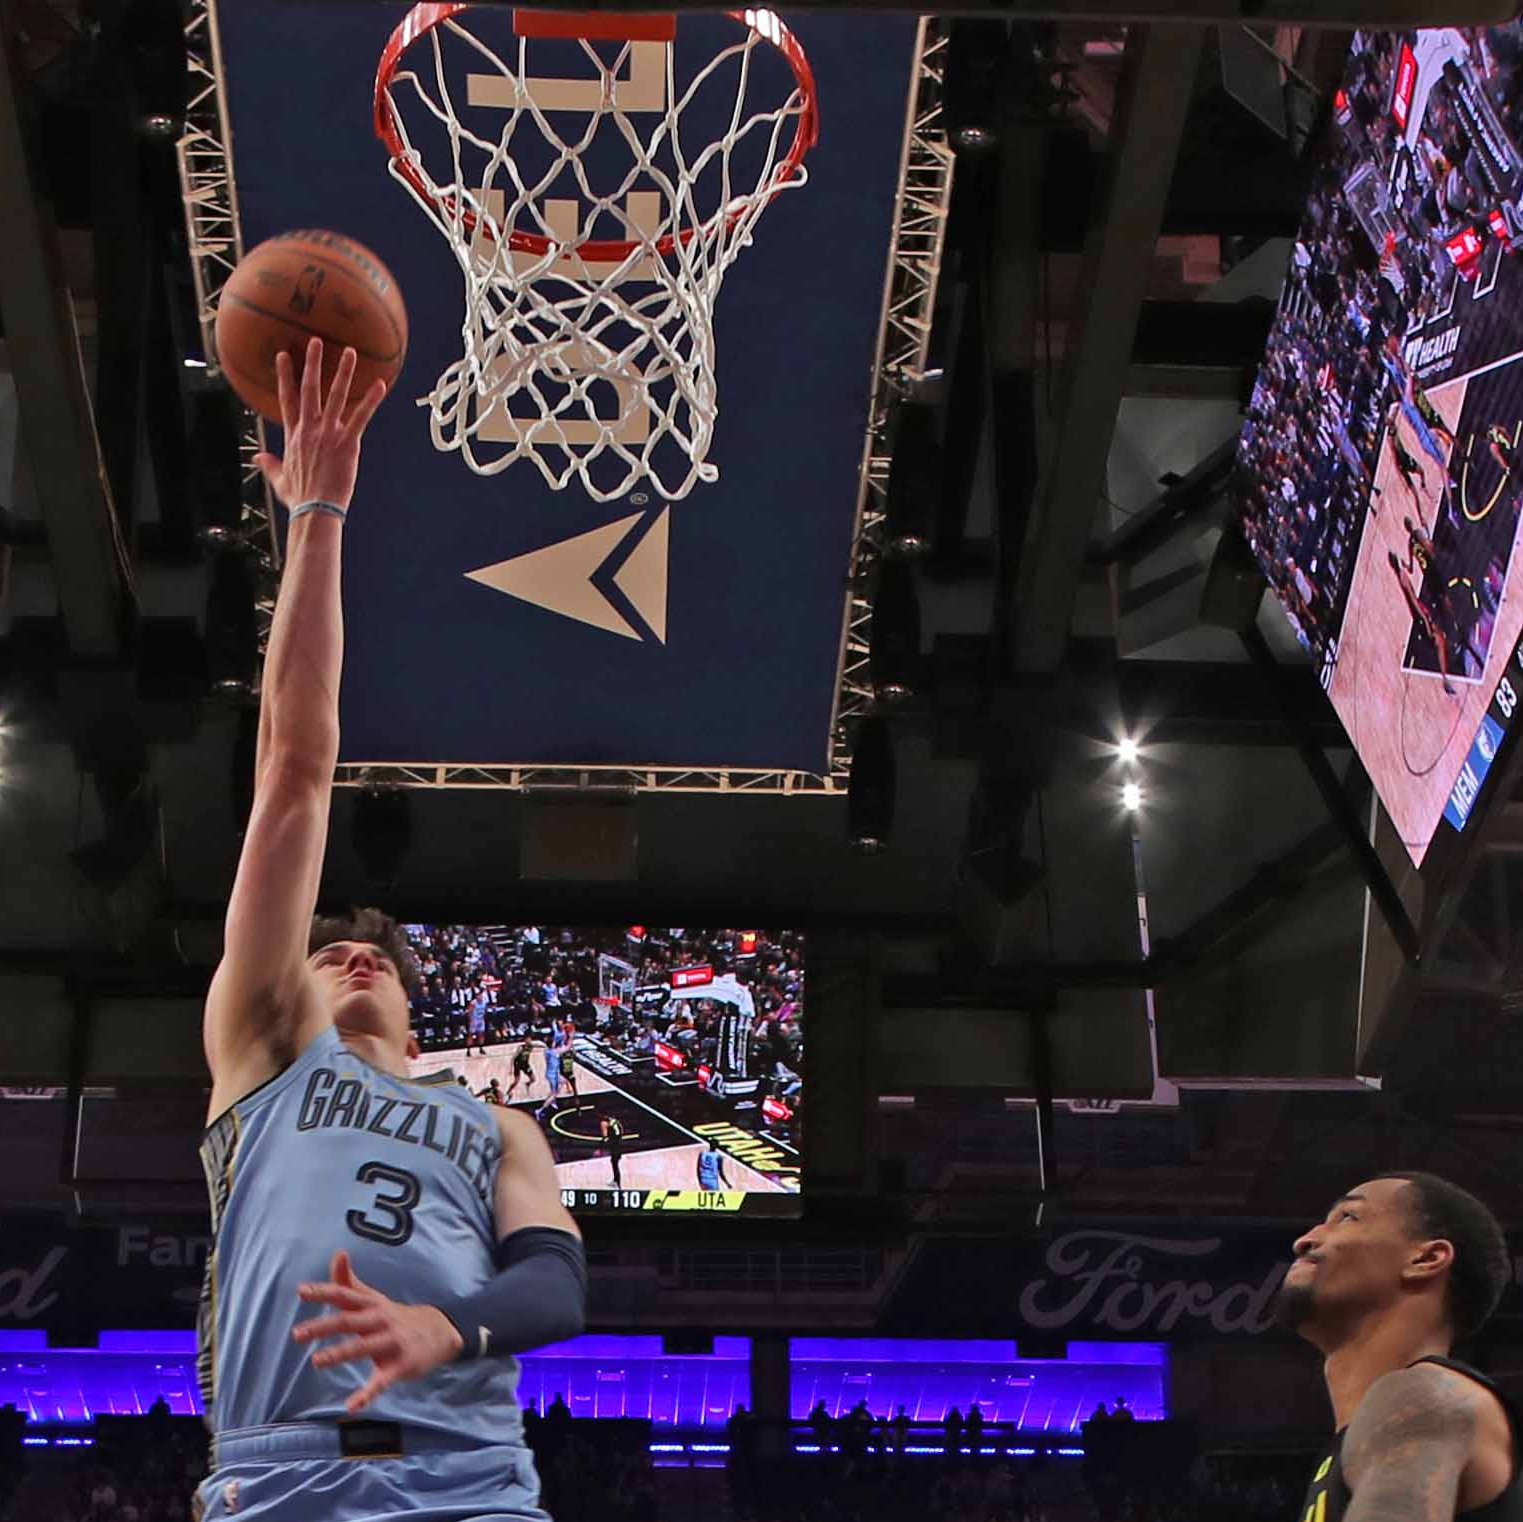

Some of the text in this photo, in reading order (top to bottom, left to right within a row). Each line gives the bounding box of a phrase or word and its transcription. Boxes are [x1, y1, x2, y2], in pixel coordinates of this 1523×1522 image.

[1450, 770, 1480, 822] MEM
[1496, 677, 1518, 719] 83
[345, 1160, 422, 1247] 3
[584, 1190, 726, 1208] 10 110 UTA
[1018, 1229, 1293, 1334] Ford
